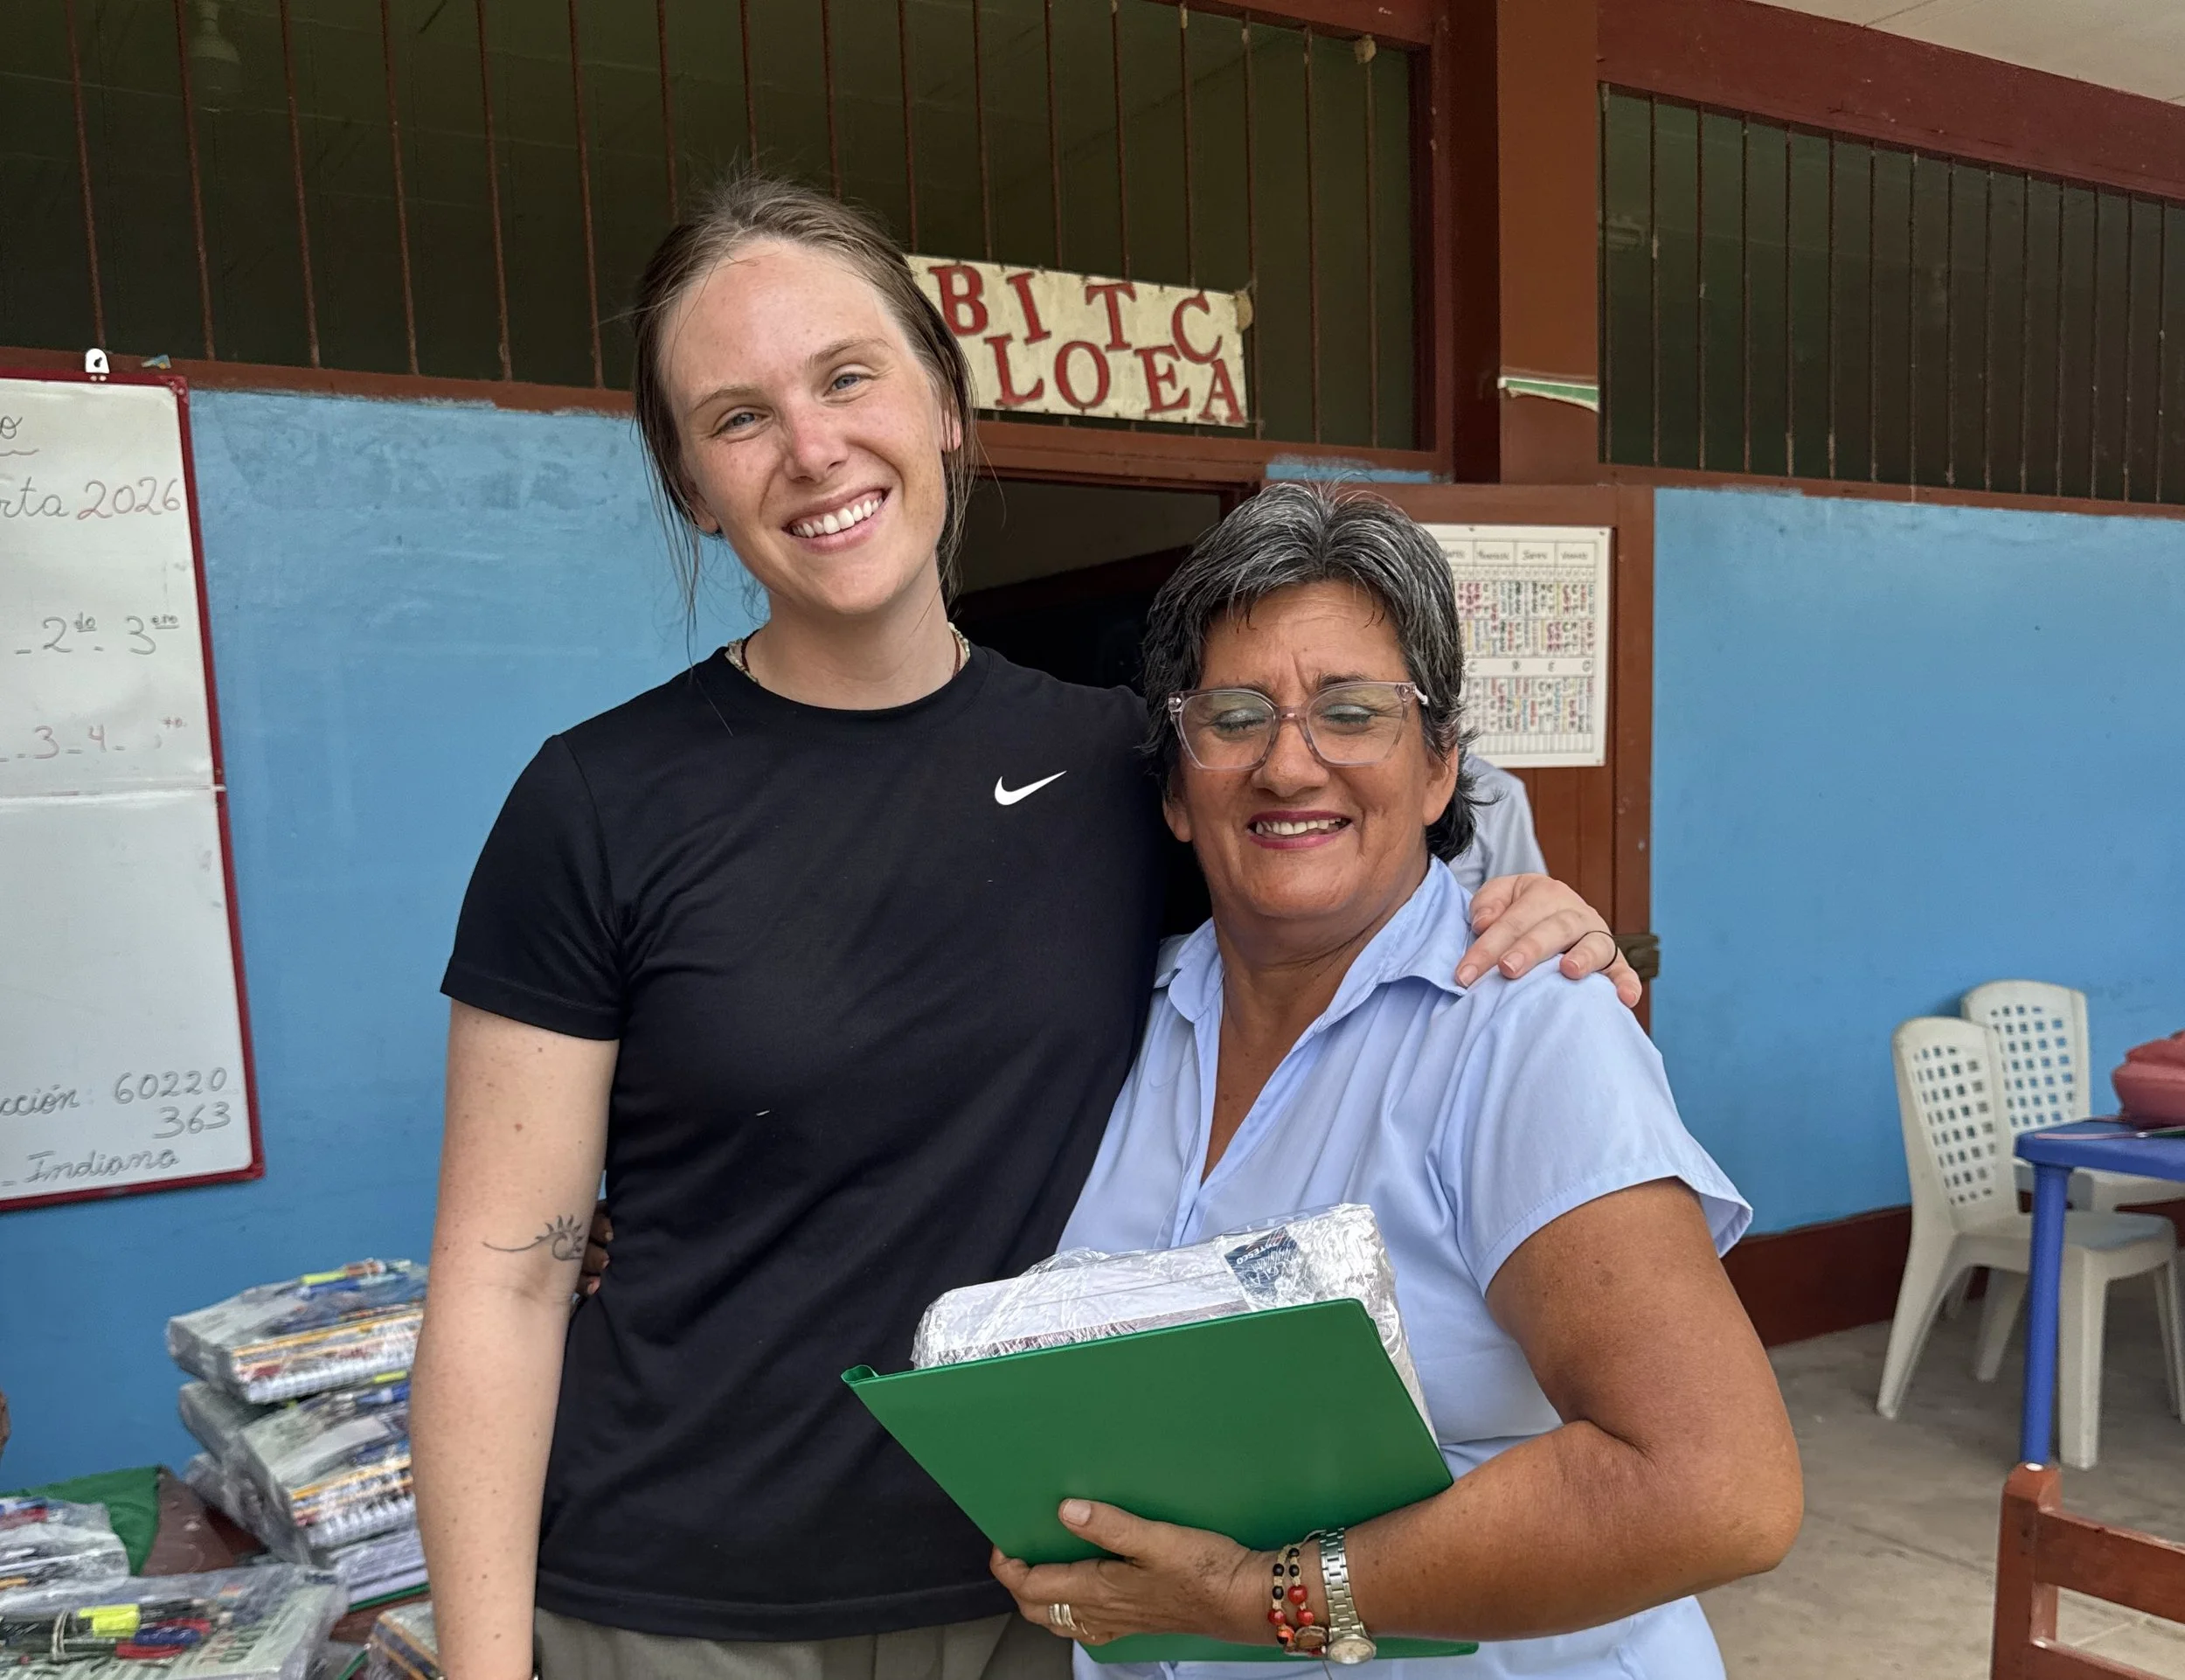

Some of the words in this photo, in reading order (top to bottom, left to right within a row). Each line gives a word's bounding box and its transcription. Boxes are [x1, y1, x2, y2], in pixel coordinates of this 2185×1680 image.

[77, 476, 181, 520] 2026
[114, 1066, 228, 1105] 60220
[152, 1100, 232, 1139] 363
[24, 1149, 181, 1184] Indiana
